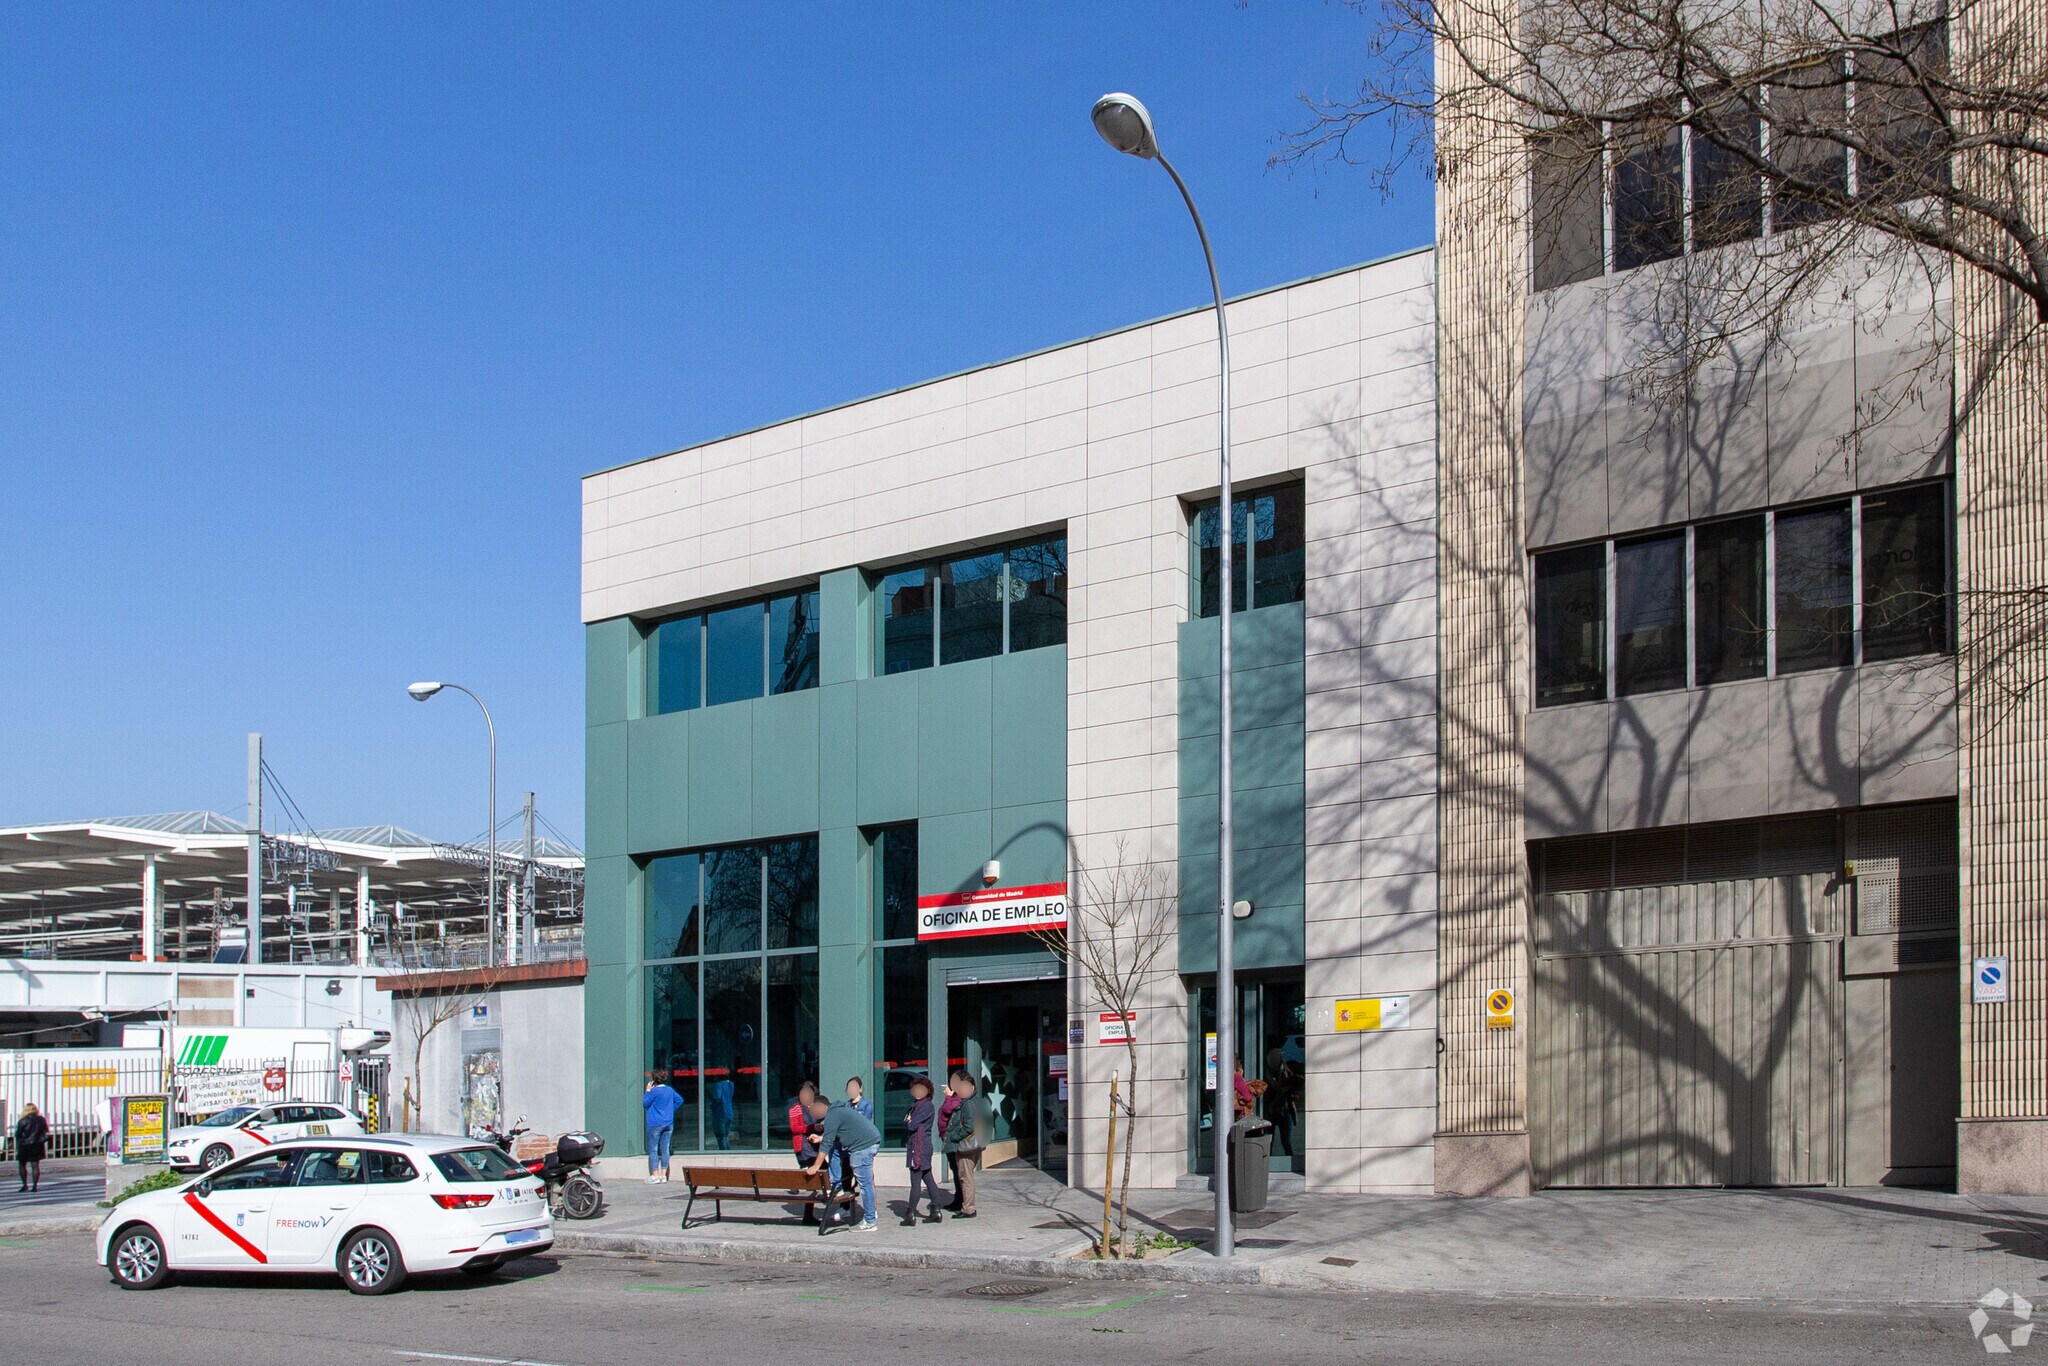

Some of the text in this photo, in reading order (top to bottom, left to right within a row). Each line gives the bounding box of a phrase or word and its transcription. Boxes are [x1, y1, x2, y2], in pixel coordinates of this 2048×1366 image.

[972, 892, 998, 900] Comunidad
[923, 902, 1064, 927] OFICINA DE EMPLEO
[1978, 987, 2004, 995] VADO
